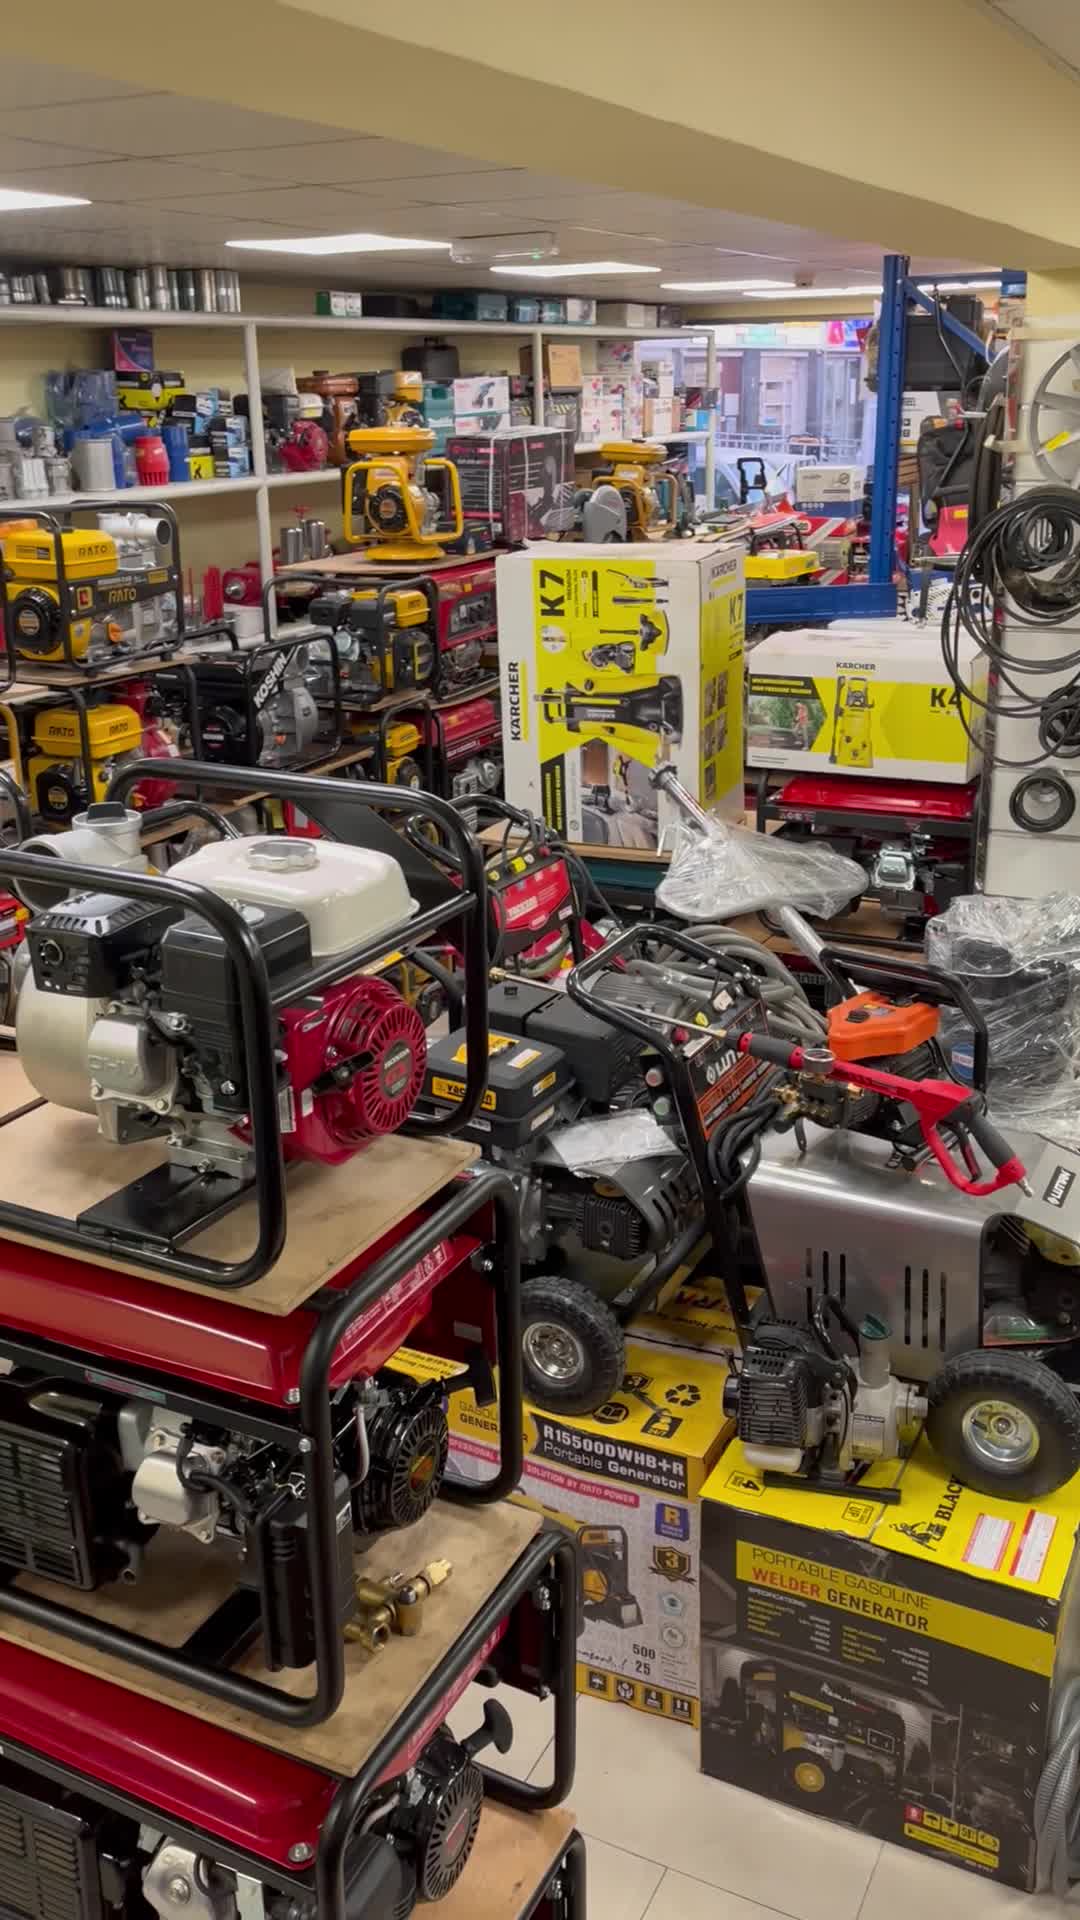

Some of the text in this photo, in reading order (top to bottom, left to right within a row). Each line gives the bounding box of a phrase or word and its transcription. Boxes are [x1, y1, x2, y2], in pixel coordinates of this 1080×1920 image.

[108, 588, 137, 604] RATO
[253, 652, 287, 709] KOSHIN
[544, 1425, 684, 1476] R15500DWHB+R
[544, 1441, 685, 1490] Portable Generator
[526, 1464, 564, 1485] SOLUTION
[567, 1477, 578, 1488] BY
[603, 1486, 635, 1504] POWER
[752, 1547, 929, 1611] PORTABLE GASOLINE
[752, 1567, 821, 1599] WELDER
[827, 1588, 929, 1632] GENERATOR
[632, 1643, 656, 1660] 500
[635, 1660, 650, 1677] 25
